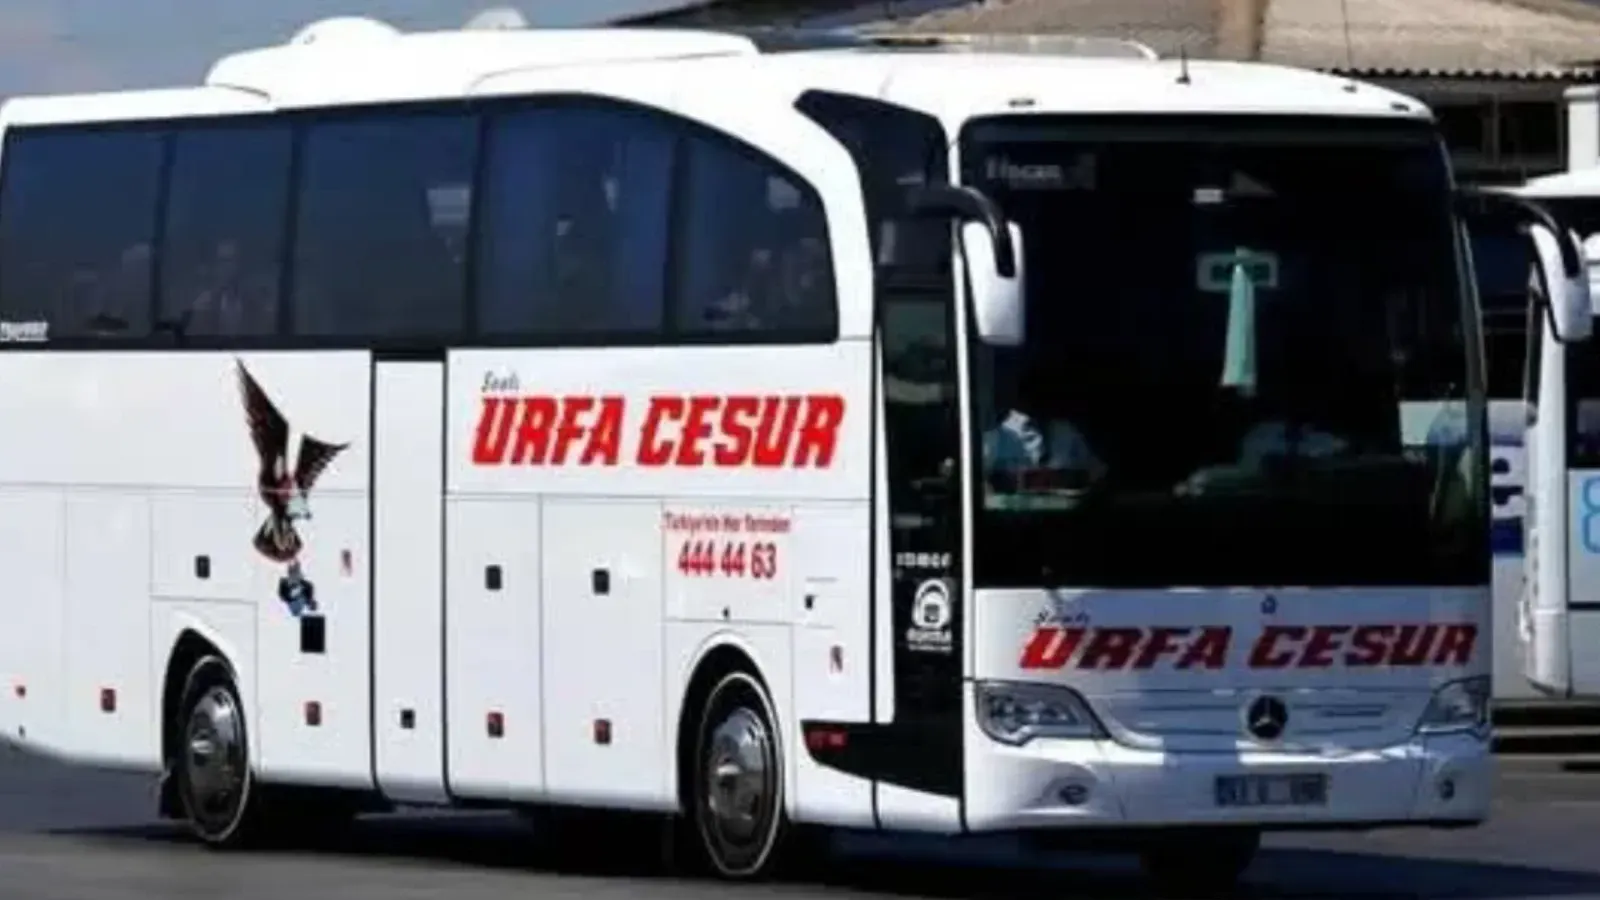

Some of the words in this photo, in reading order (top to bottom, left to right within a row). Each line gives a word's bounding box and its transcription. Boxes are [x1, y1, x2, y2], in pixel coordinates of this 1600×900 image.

[472, 396, 625, 466] URFA
[636, 396, 845, 468] CESUR
[678, 541, 715, 577] 444
[720, 541, 746, 578] 44
[751, 541, 777, 579] 63
[1019, 625, 1233, 669] URFA
[1248, 621, 1478, 669] CESUR
